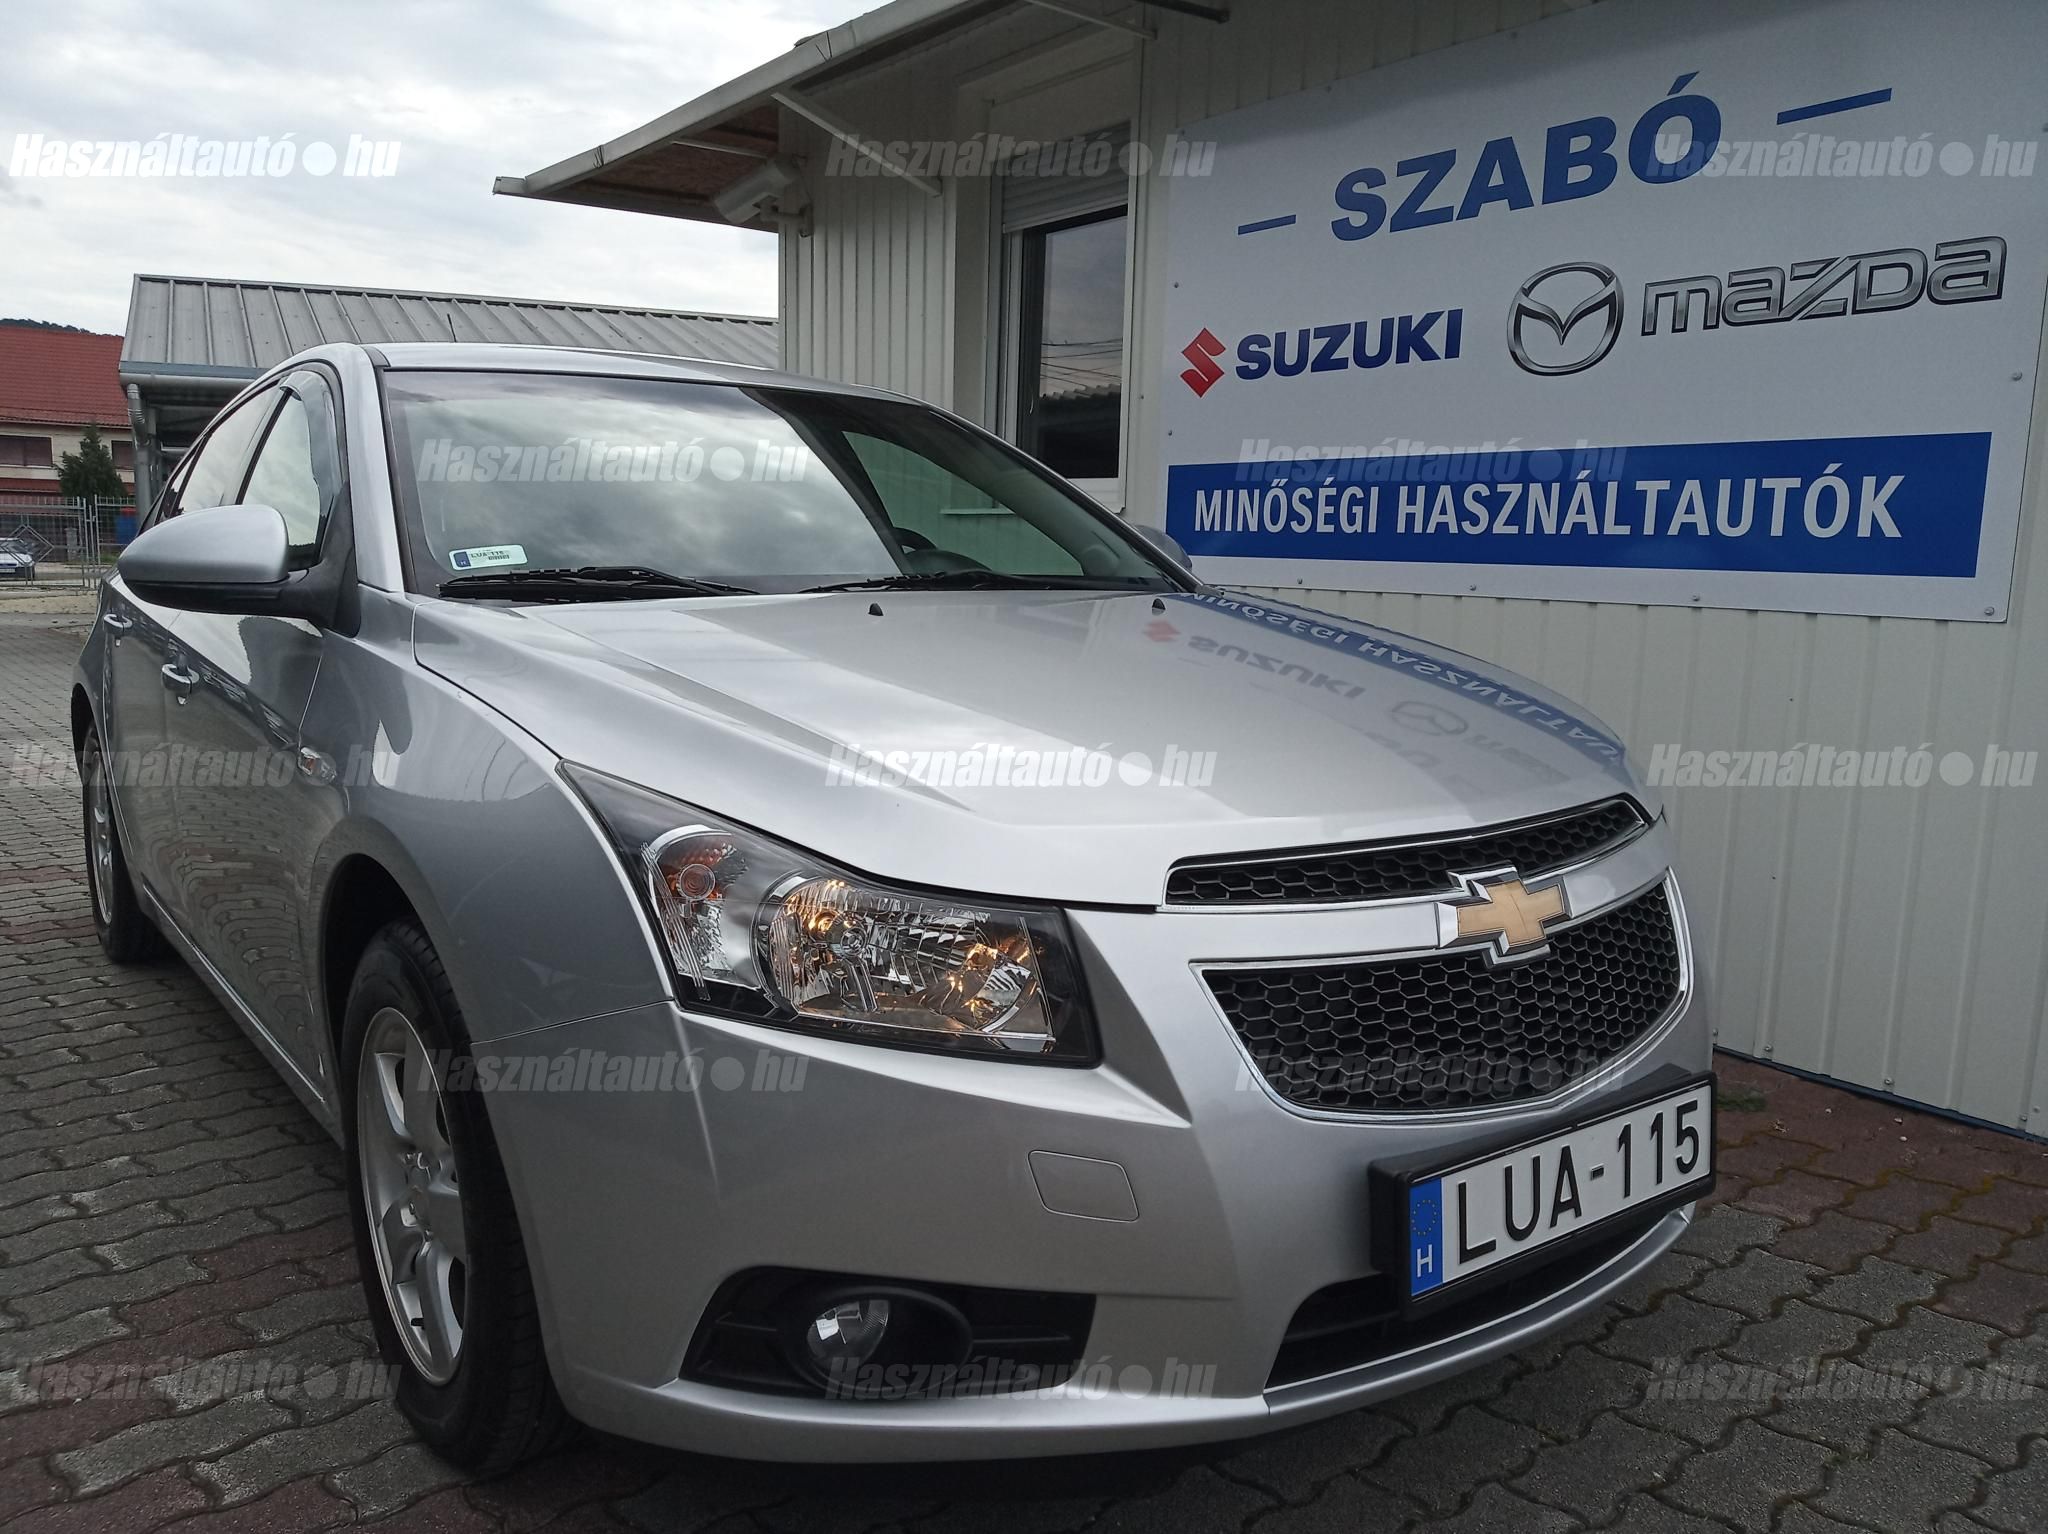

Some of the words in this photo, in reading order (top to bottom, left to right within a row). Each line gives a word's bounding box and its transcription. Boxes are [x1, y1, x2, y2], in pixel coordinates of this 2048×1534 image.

[1331, 71, 1721, 241] SZABÓ
[1235, 308, 1463, 380] SUZUKI
[1194, 477, 1379, 533] MINŐSÉGI
[1396, 463, 1905, 538] HASZNÁLTAUTÓK
[1458, 1099, 1699, 1265] LUA-115
[1416, 1245, 1433, 1278] H
